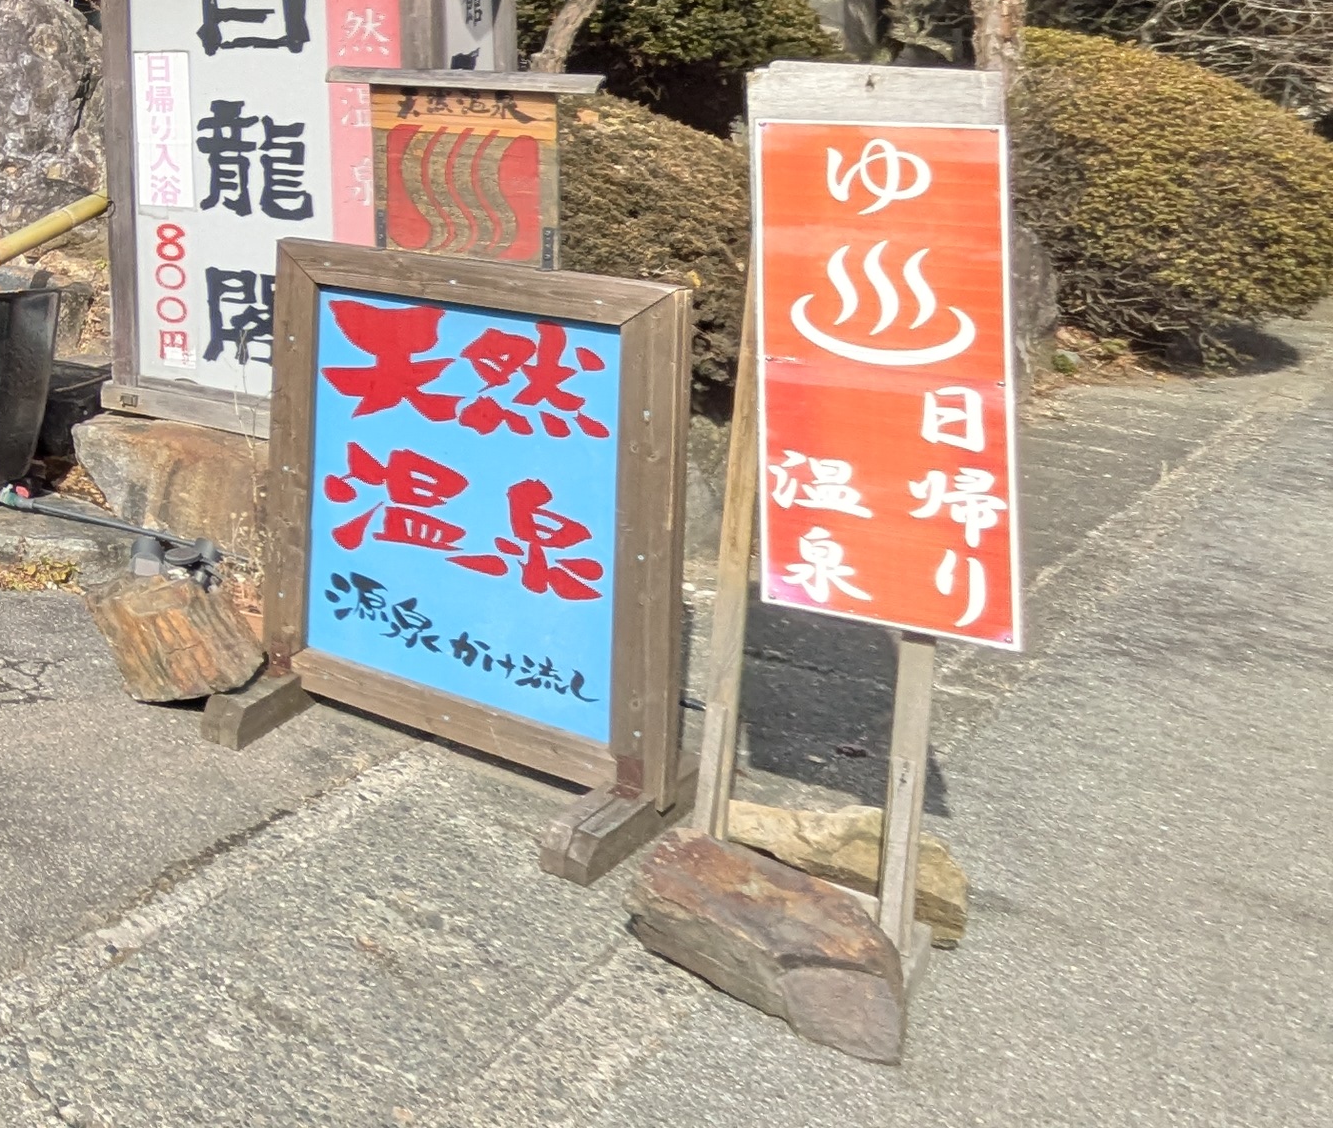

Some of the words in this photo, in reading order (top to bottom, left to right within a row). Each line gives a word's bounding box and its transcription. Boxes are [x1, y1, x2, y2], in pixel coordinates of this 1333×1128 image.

[145, 55, 181, 205] 日帰り入浴
[826, 138, 932, 215] ゆ
[321, 299, 610, 439] 天然
[323, 442, 604, 601] 温泉
[769, 450, 874, 603] 温泉
[909, 386, 1009, 627] 日帰り
[324, 571, 599, 703] 源泉かけ流し
